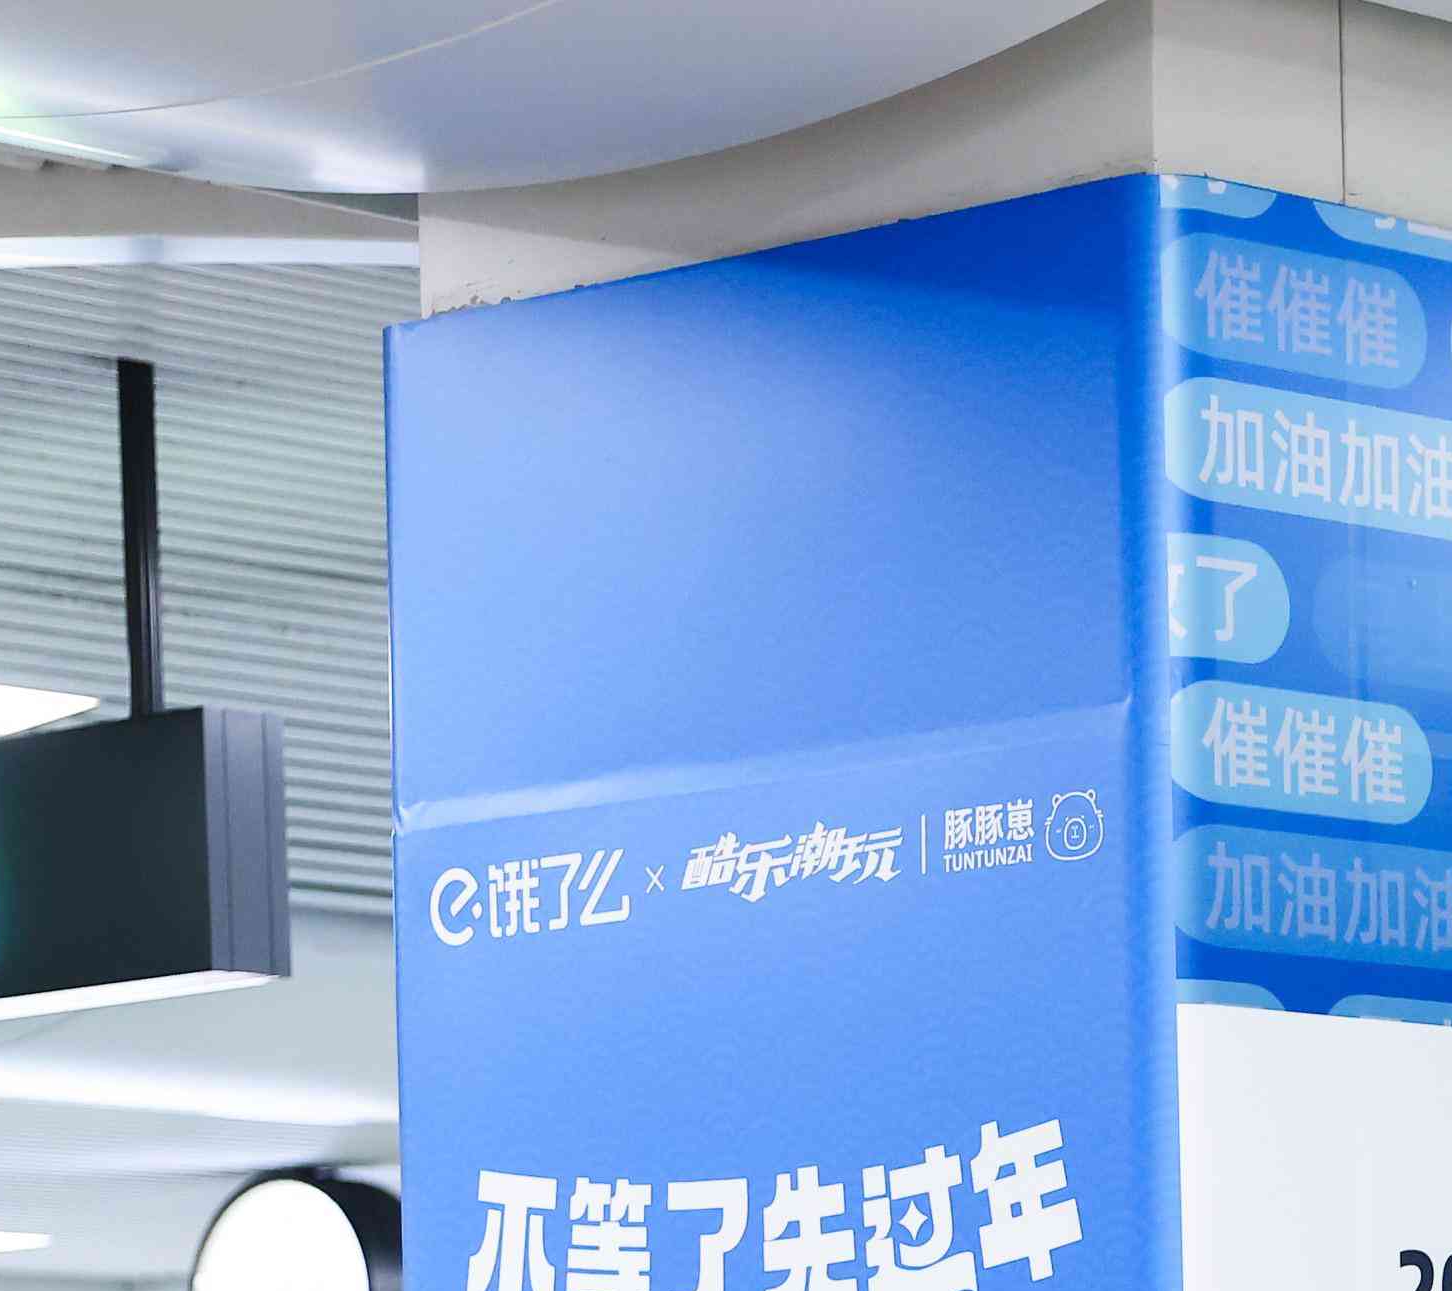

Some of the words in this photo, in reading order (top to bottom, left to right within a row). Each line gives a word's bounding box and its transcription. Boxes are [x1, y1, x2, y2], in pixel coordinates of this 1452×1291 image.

[1195, 247, 1400, 371] 催催催
[1202, 697, 1407, 806] 催催催
[681, 821, 904, 903] 酷乐潮玩
[944, 798, 1034, 851] 豚豚崽
[943, 844, 1034, 874] TUNTUNZAI
